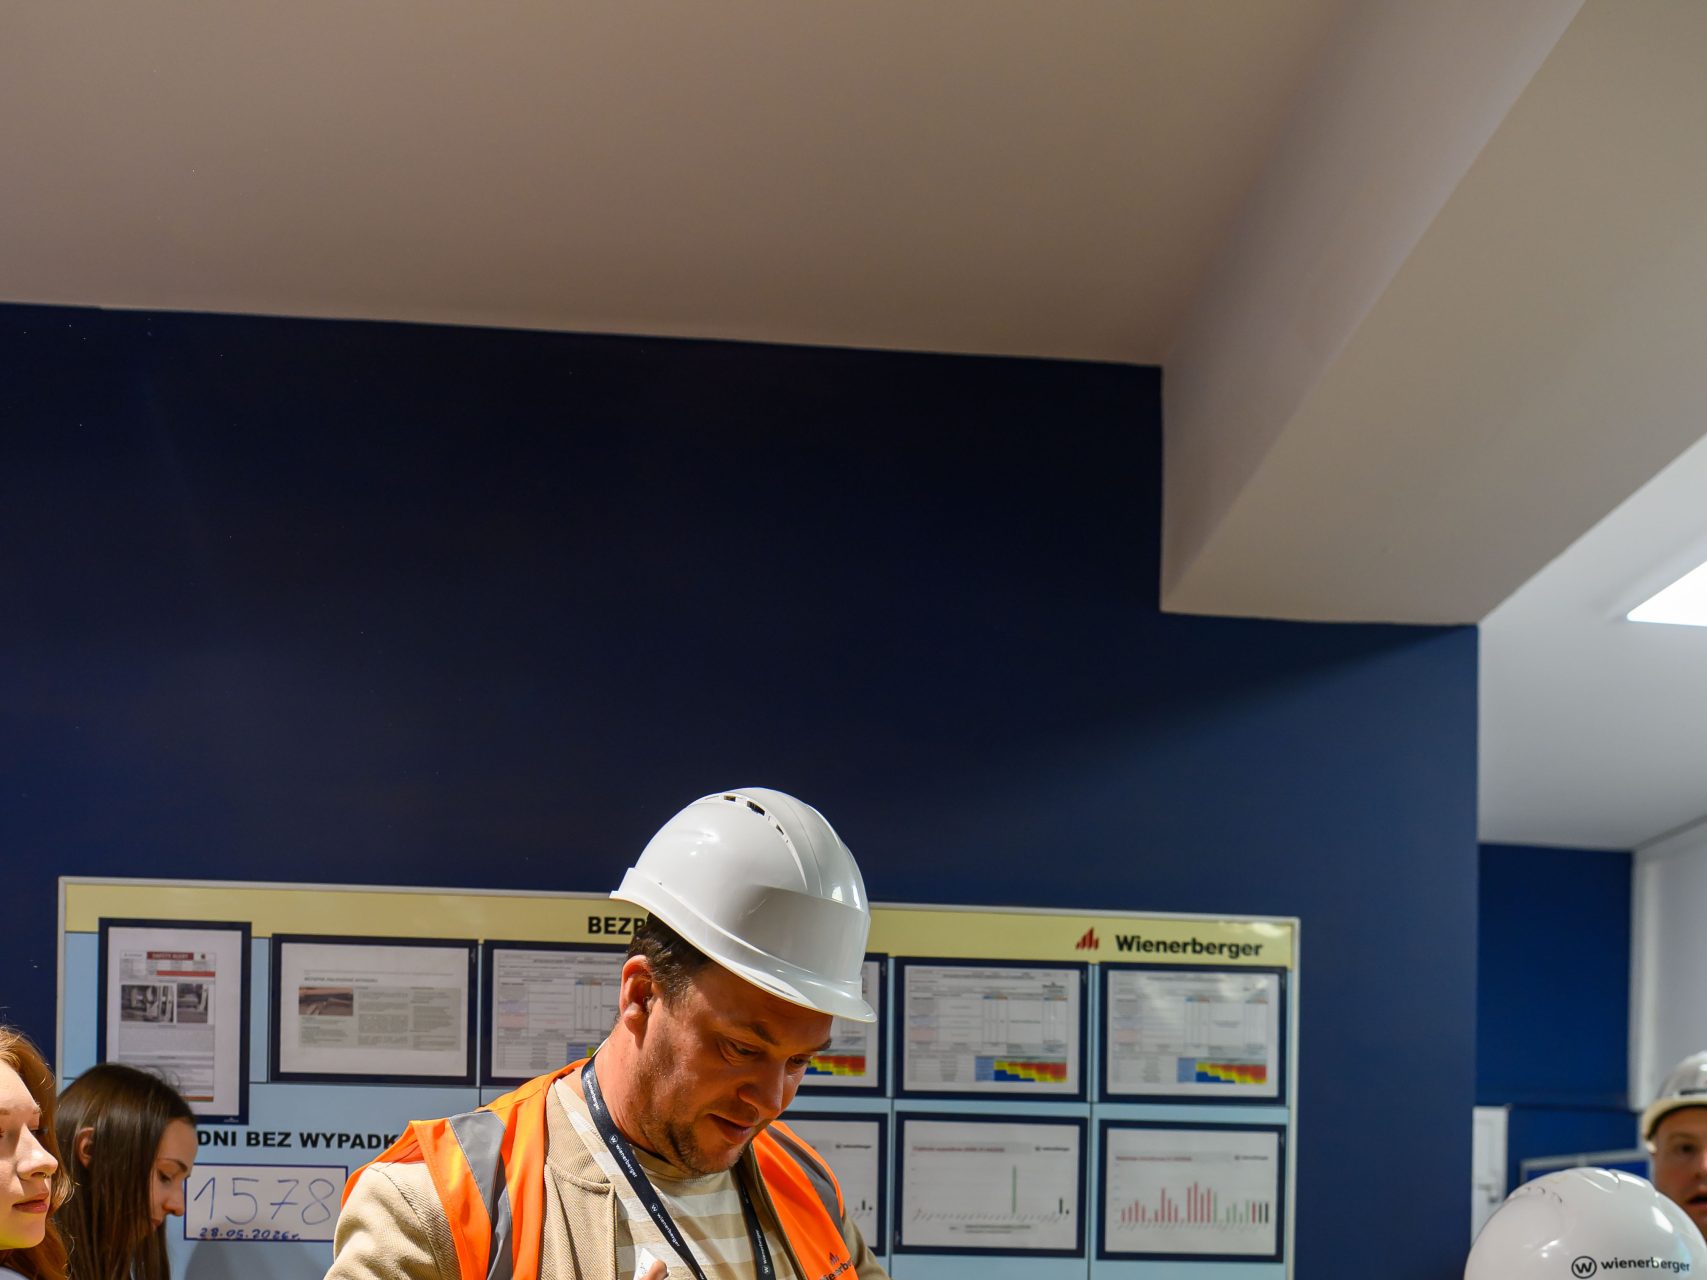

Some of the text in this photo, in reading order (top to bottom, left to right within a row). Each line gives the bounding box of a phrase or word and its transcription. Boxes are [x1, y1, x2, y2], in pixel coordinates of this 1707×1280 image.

[1115, 934, 1263, 959] Wienerberger
[197, 1130, 237, 1146] DNI
[246, 1131, 292, 1147] BEZ
[616, 1144, 638, 1178] wienerberger
[194, 1176, 335, 1226] 1578
[657, 1213, 681, 1247] wienerberger
[1601, 1257, 1690, 1273] wienerberger
